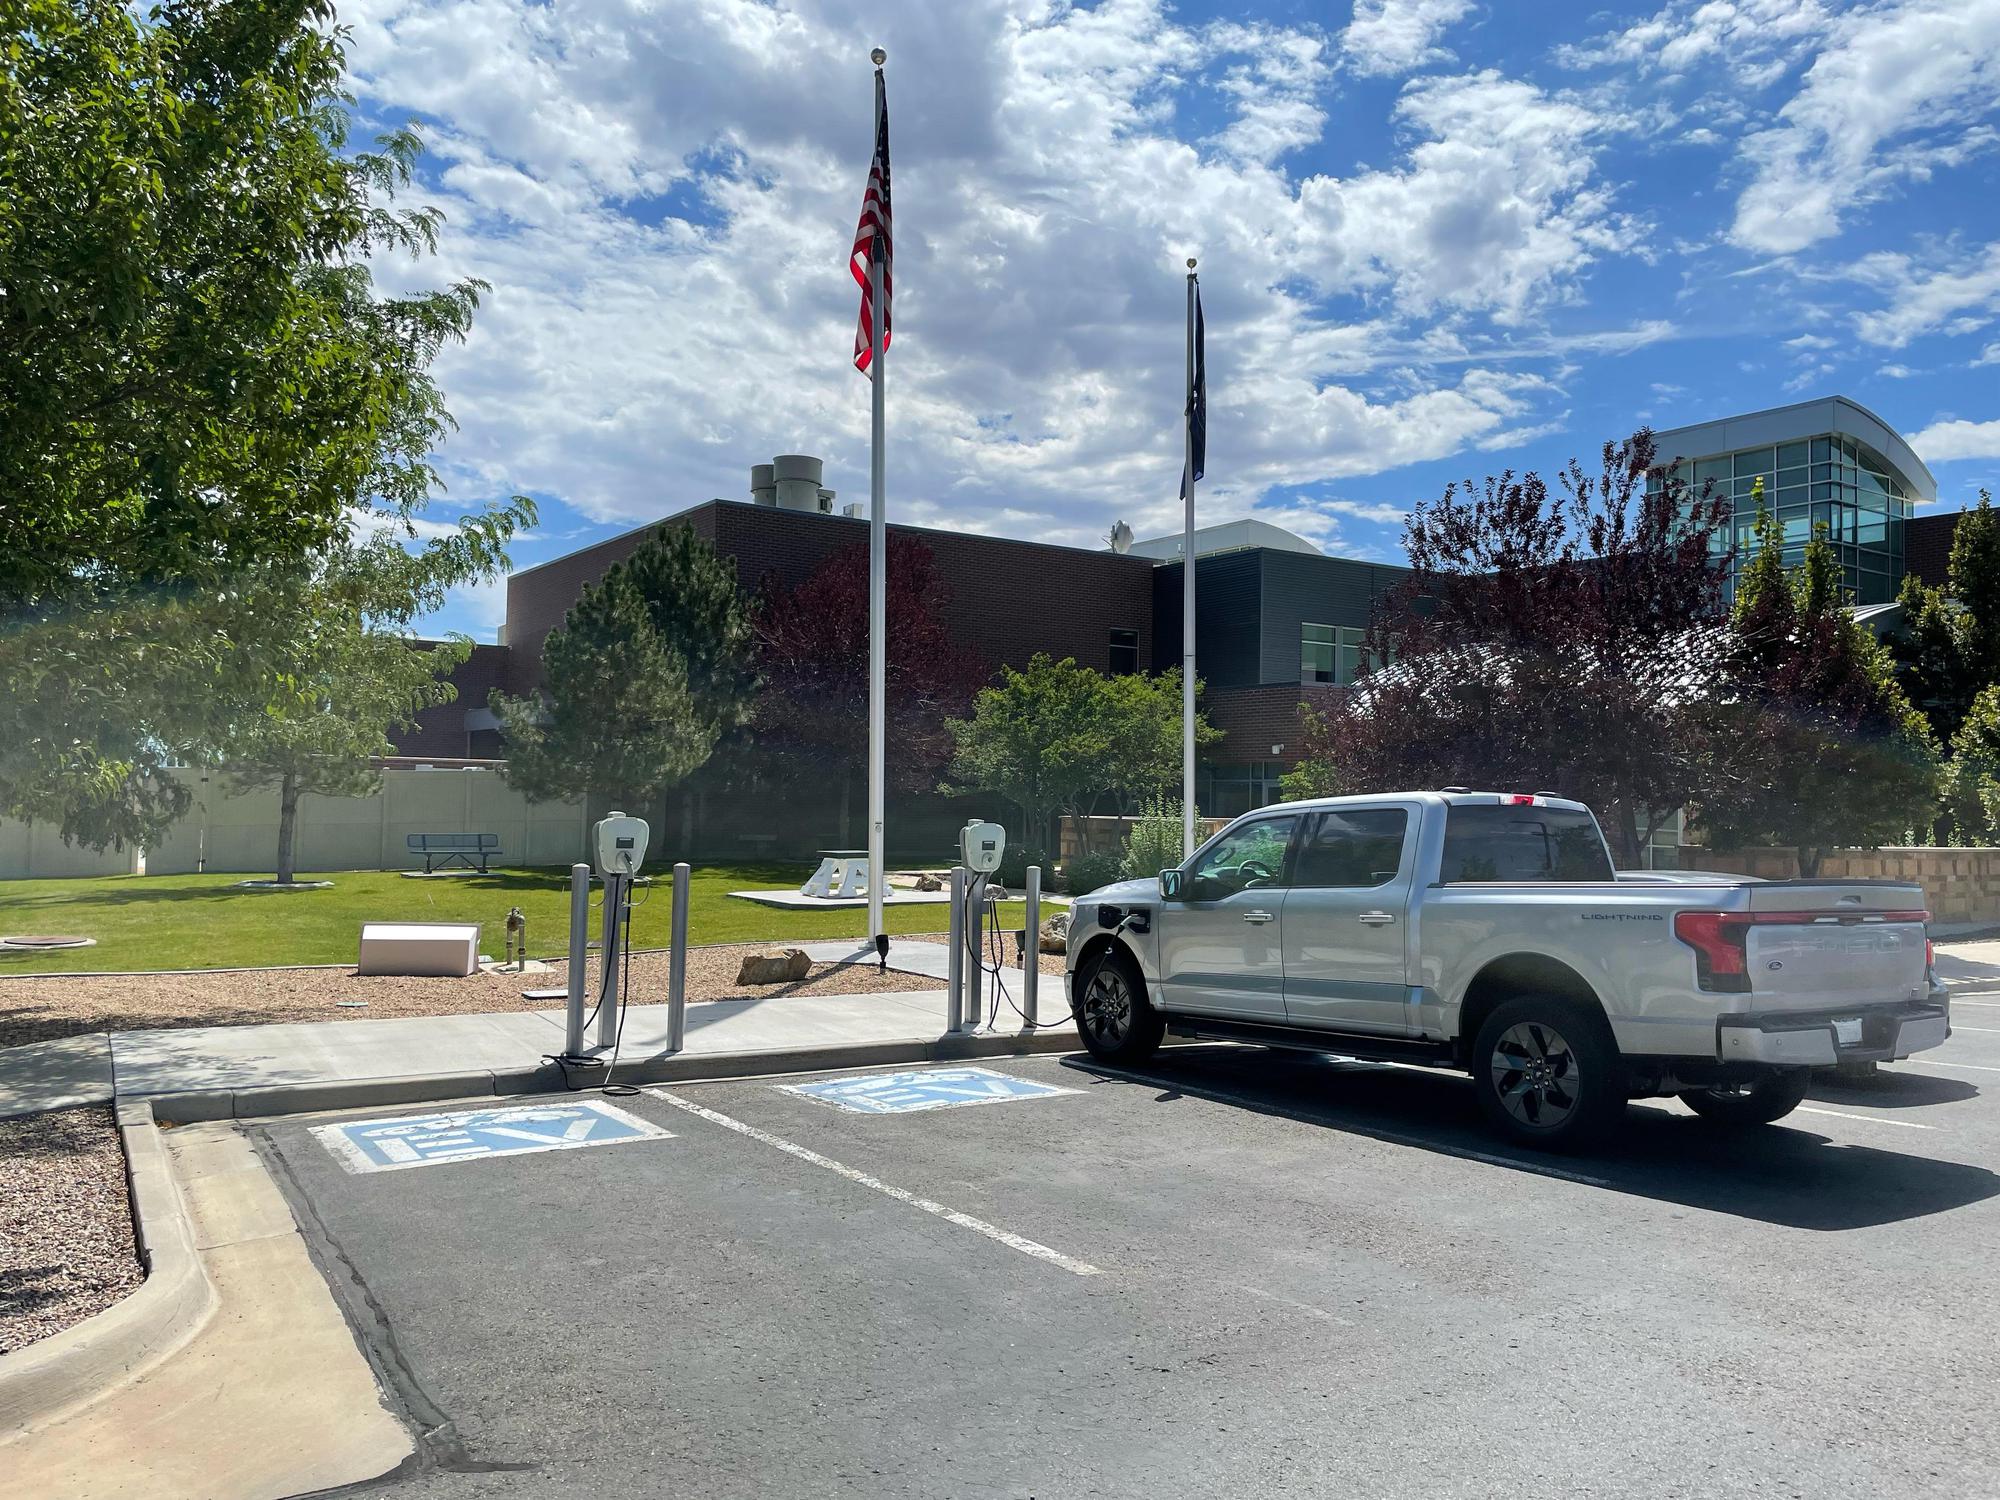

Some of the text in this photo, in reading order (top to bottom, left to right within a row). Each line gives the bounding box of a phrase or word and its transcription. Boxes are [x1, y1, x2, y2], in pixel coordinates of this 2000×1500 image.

[1581, 913, 1664, 921] LIGHTNING
[845, 1079, 1015, 1111] EV
[372, 1118, 599, 1163] EV
